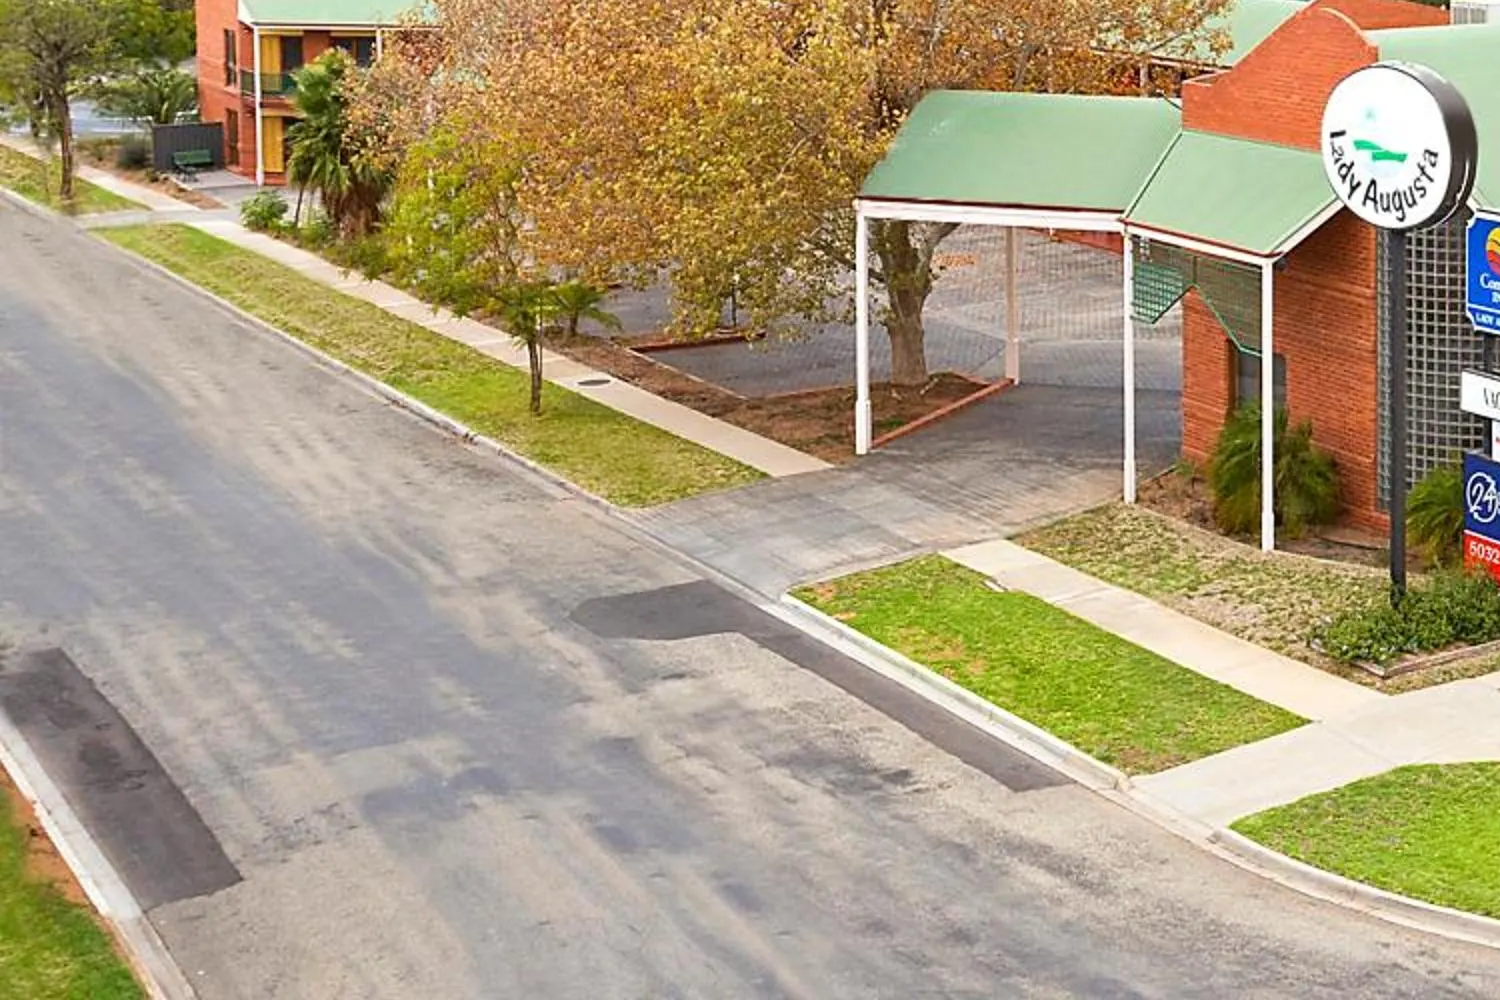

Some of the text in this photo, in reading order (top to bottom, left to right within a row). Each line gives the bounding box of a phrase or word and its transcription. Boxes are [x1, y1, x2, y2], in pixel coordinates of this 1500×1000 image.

[1330, 130, 1439, 222] Lady Augusta
[1469, 541, 1500, 565] 5032
